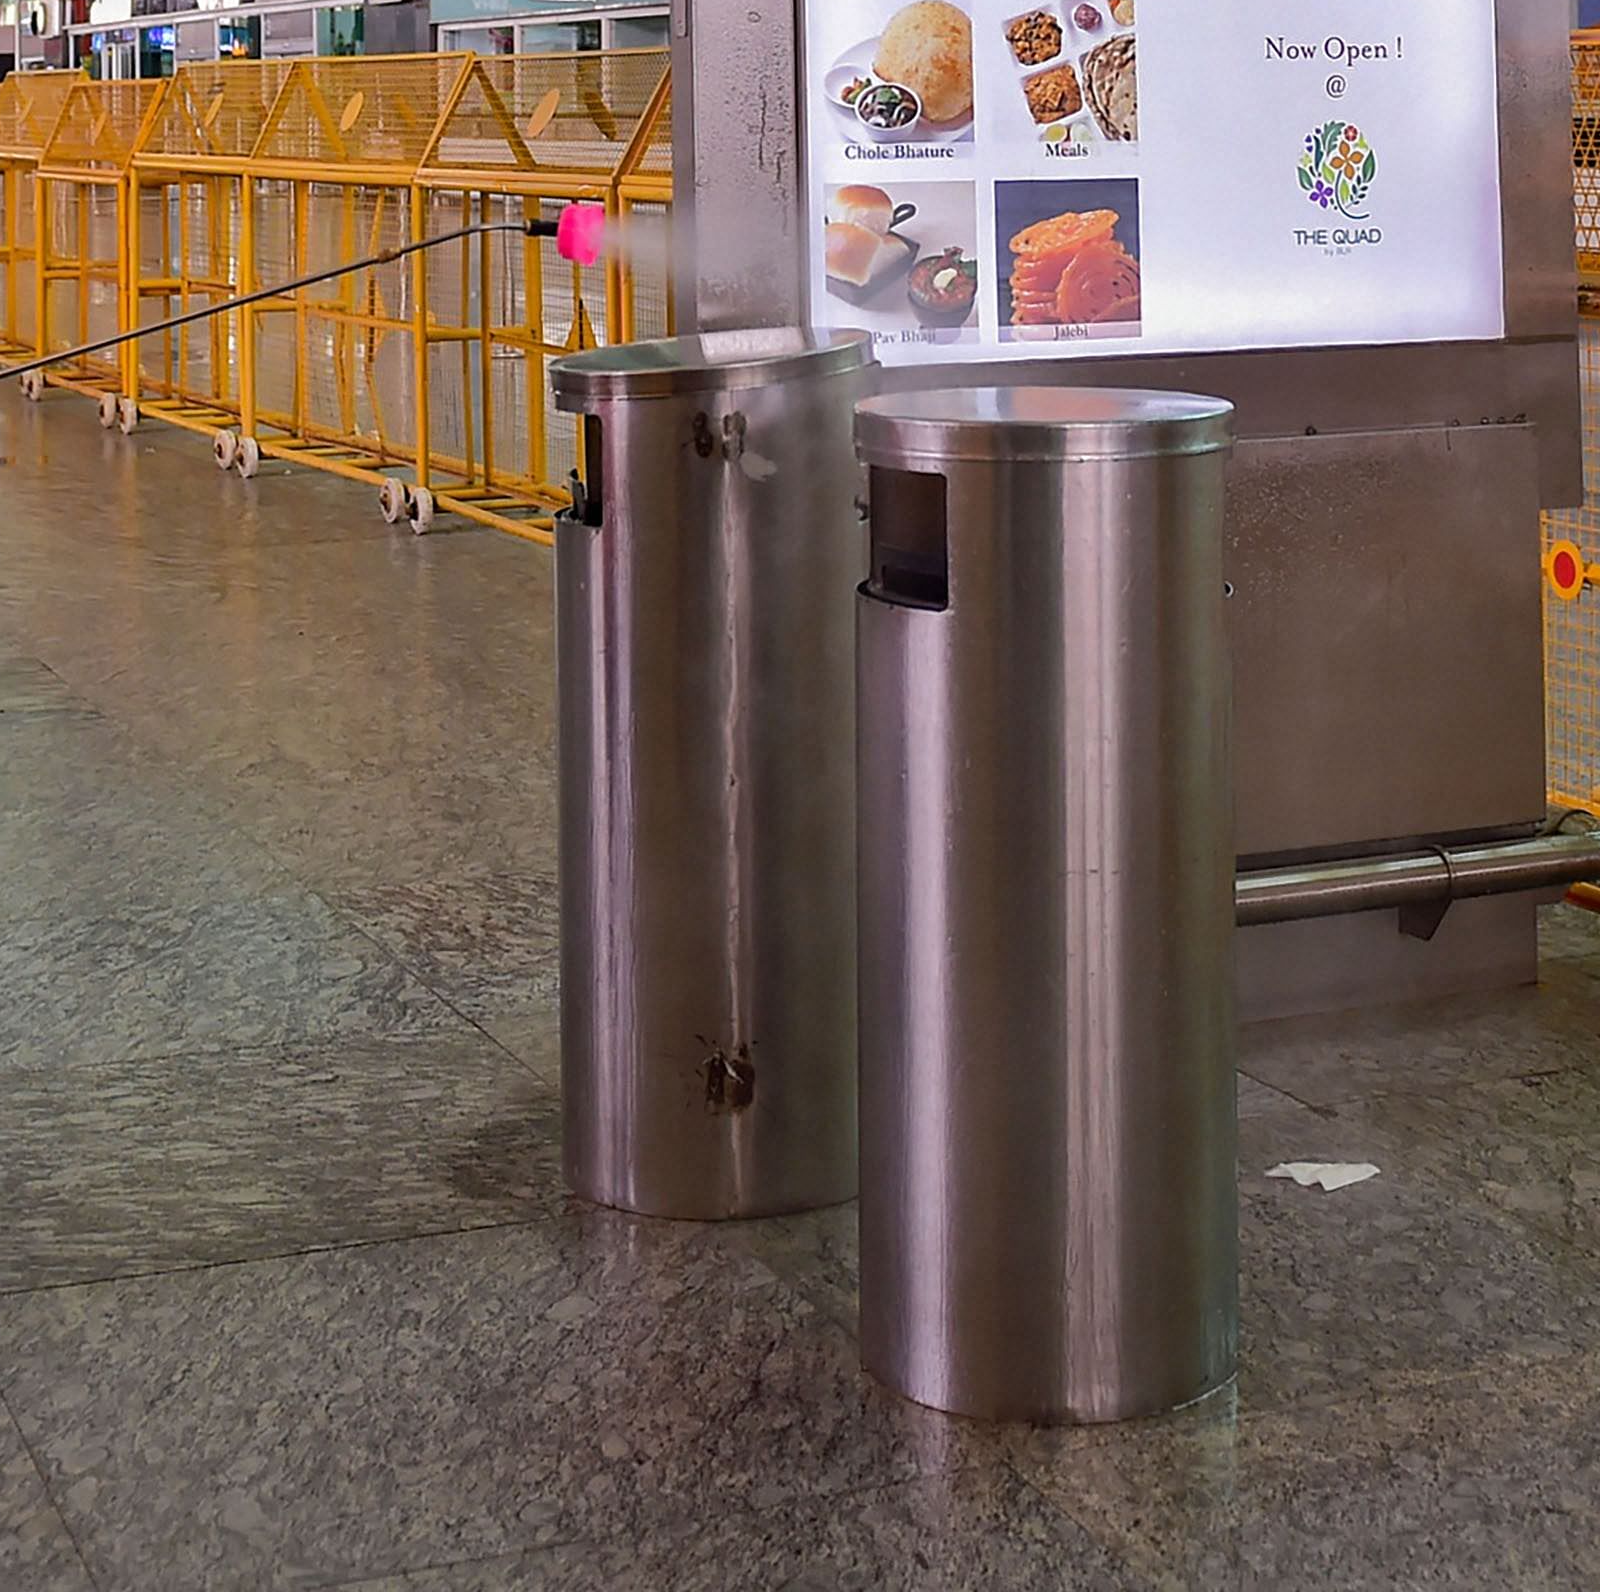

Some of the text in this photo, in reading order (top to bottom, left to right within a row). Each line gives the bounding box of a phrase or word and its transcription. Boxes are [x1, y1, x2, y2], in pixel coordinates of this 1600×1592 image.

[1265, 38, 1316, 59] Now
[1324, 38, 1388, 66] Open
[1326, 76, 1346, 98] @
[844, 145, 954, 160] Chole Bhature
[1045, 143, 1089, 157] Meals
[1293, 229, 1382, 245] THE QUAD
[873, 332, 896, 344] Pav
[1054, 326, 1089, 339] Jalebi
